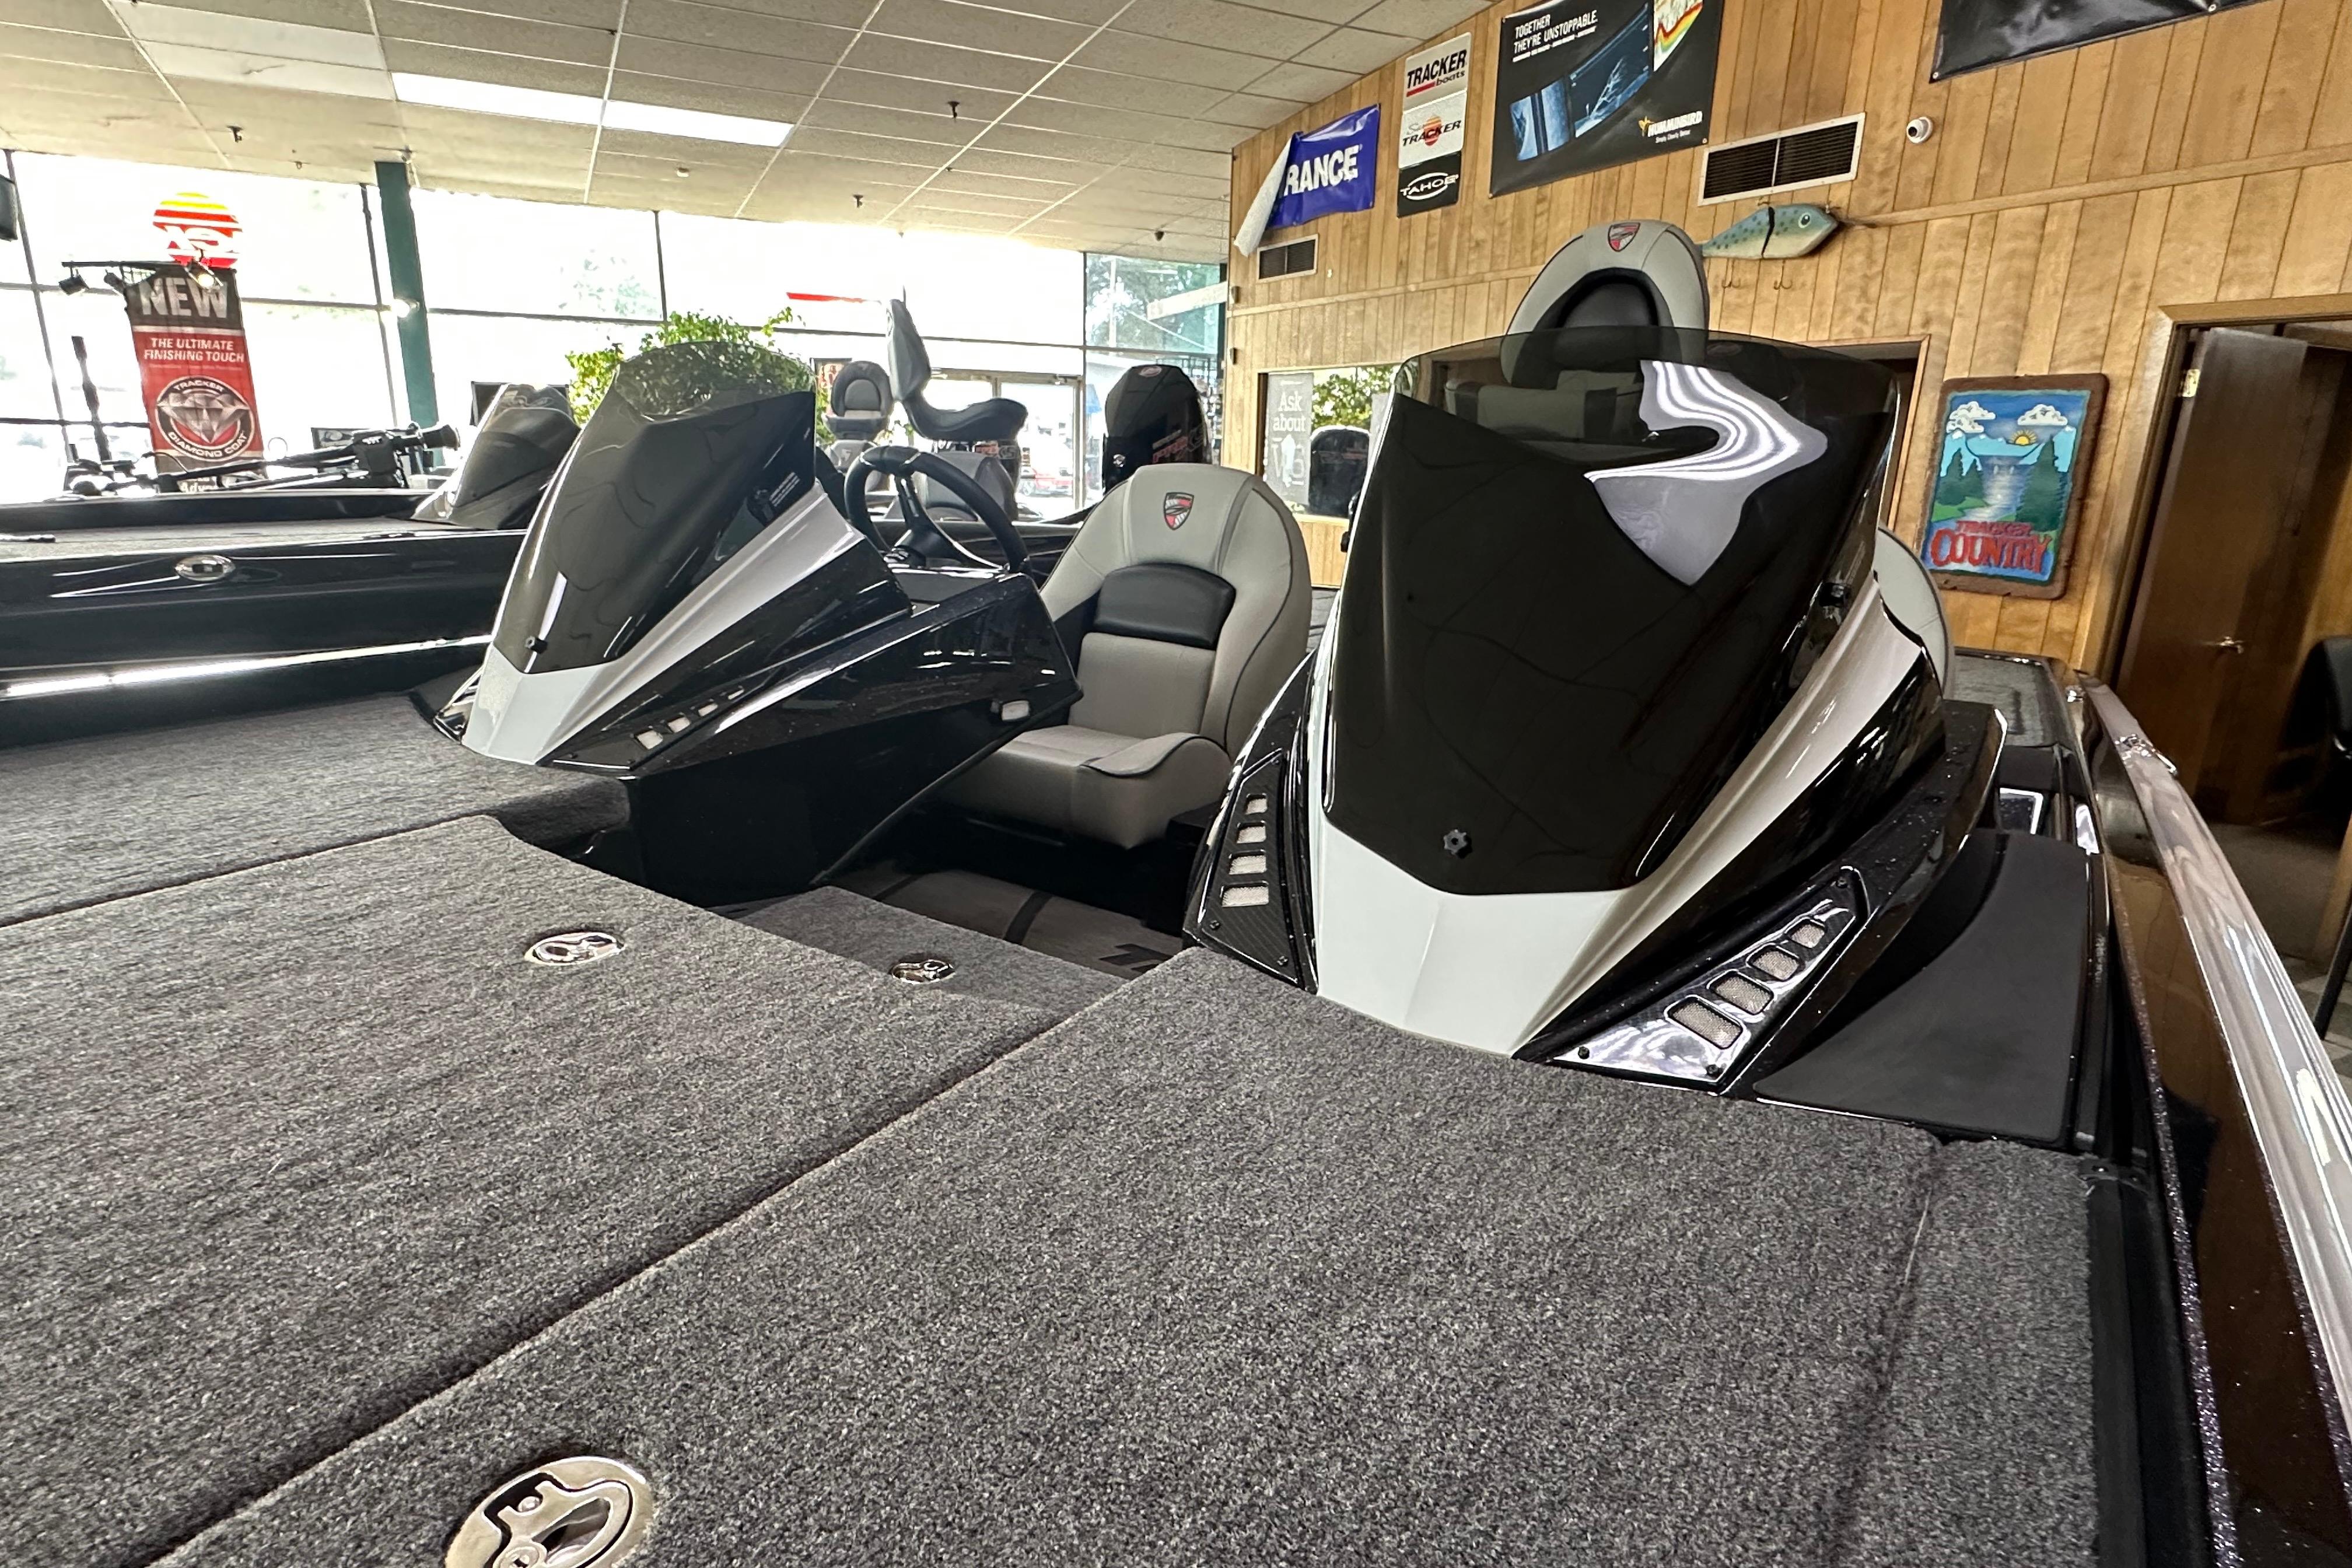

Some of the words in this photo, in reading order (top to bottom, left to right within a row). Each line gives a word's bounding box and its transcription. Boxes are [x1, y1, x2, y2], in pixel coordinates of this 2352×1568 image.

[1514, 32, 1541, 54] THEY'RE
[1544, 10, 1598, 42] UNSTOPPABLE.
[1515, 14, 1550, 39] TOGETHER
[1408, 50, 1467, 88] TRACKER
[1436, 71, 1465, 86] boats
[1402, 120, 1461, 146] TRACKER
[1400, 175, 1458, 196] TAHOE
[139, 276, 228, 318] NEW
[144, 349, 204, 360] FINISHING
[206, 352, 244, 363] TOUCH
[150, 338, 174, 348] THE
[176, 339, 234, 351] ULTIMATE
[173, 379, 225, 392] TRACKER
[1278, 391, 1303, 411] Ask
[1273, 413, 1306, 432] about
[168, 431, 223, 457] DIAMOND
[226, 432, 247, 454] COAT
[1931, 528, 2053, 573] COUNTRY
